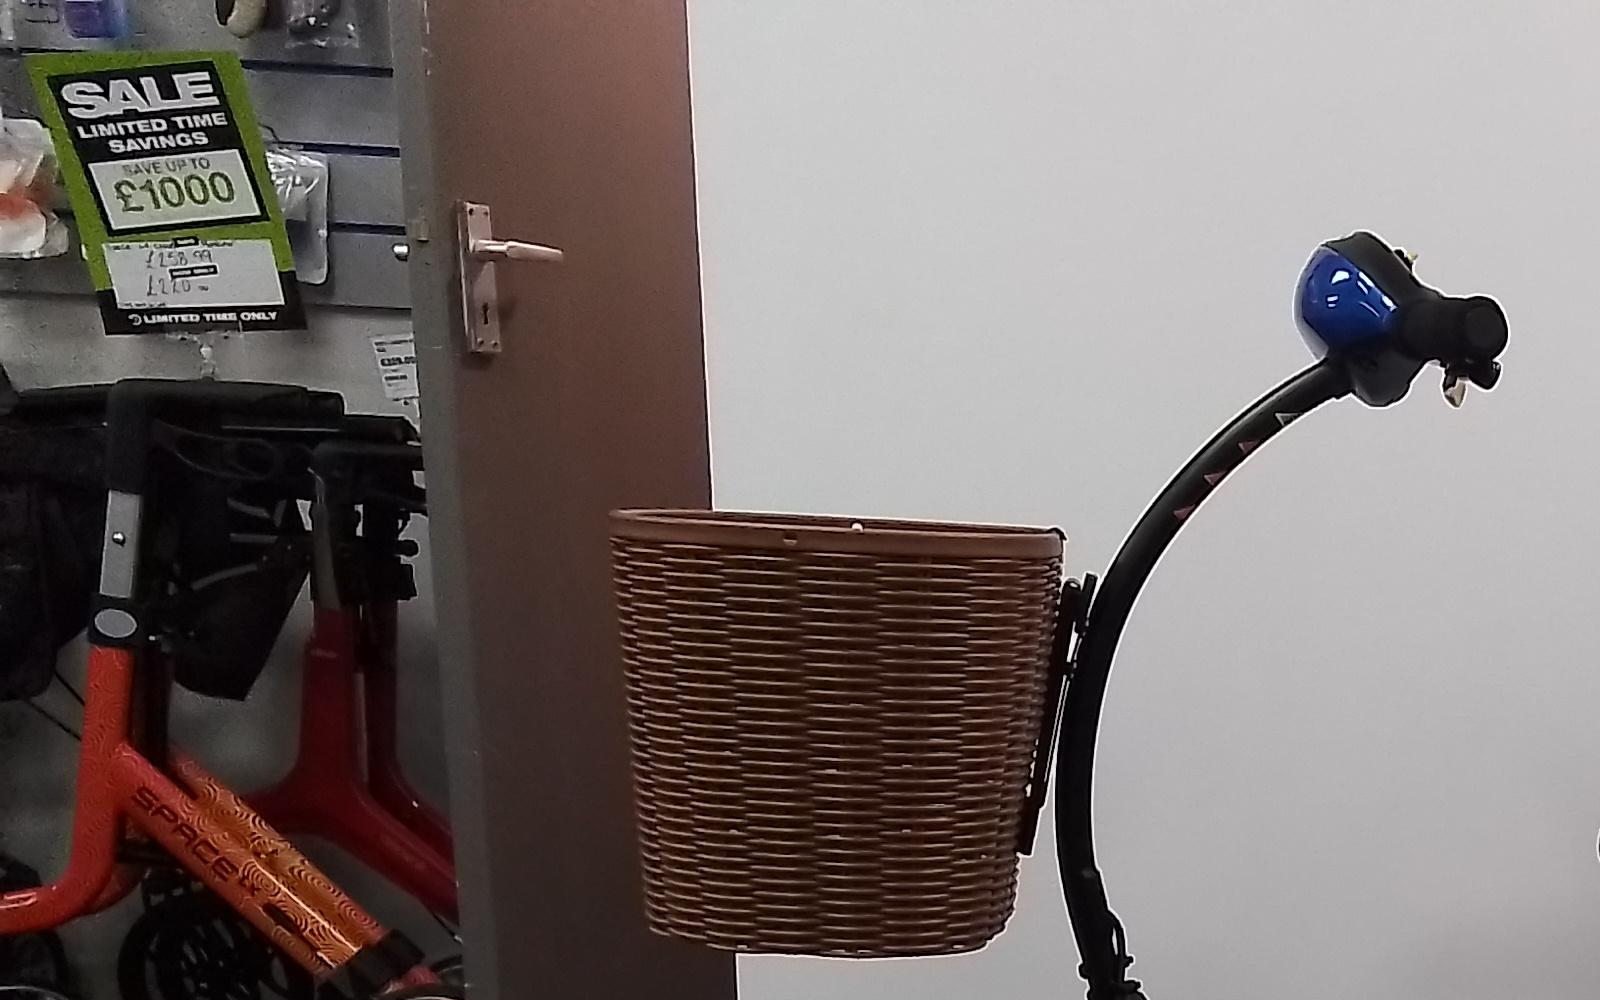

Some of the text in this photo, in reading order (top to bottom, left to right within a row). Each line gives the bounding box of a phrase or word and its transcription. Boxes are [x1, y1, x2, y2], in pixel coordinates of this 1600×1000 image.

[60, 71, 221, 120] SALE
[76, 112, 228, 139] LIMITED TIME
[108, 131, 210, 153] SAVINGS
[122, 157, 211, 176] SAVE UP TO
[113, 171, 235, 213] £1000
[143, 311, 278, 325] LIMITED TIME ONLY
[132, 785, 239, 883] SPACE
